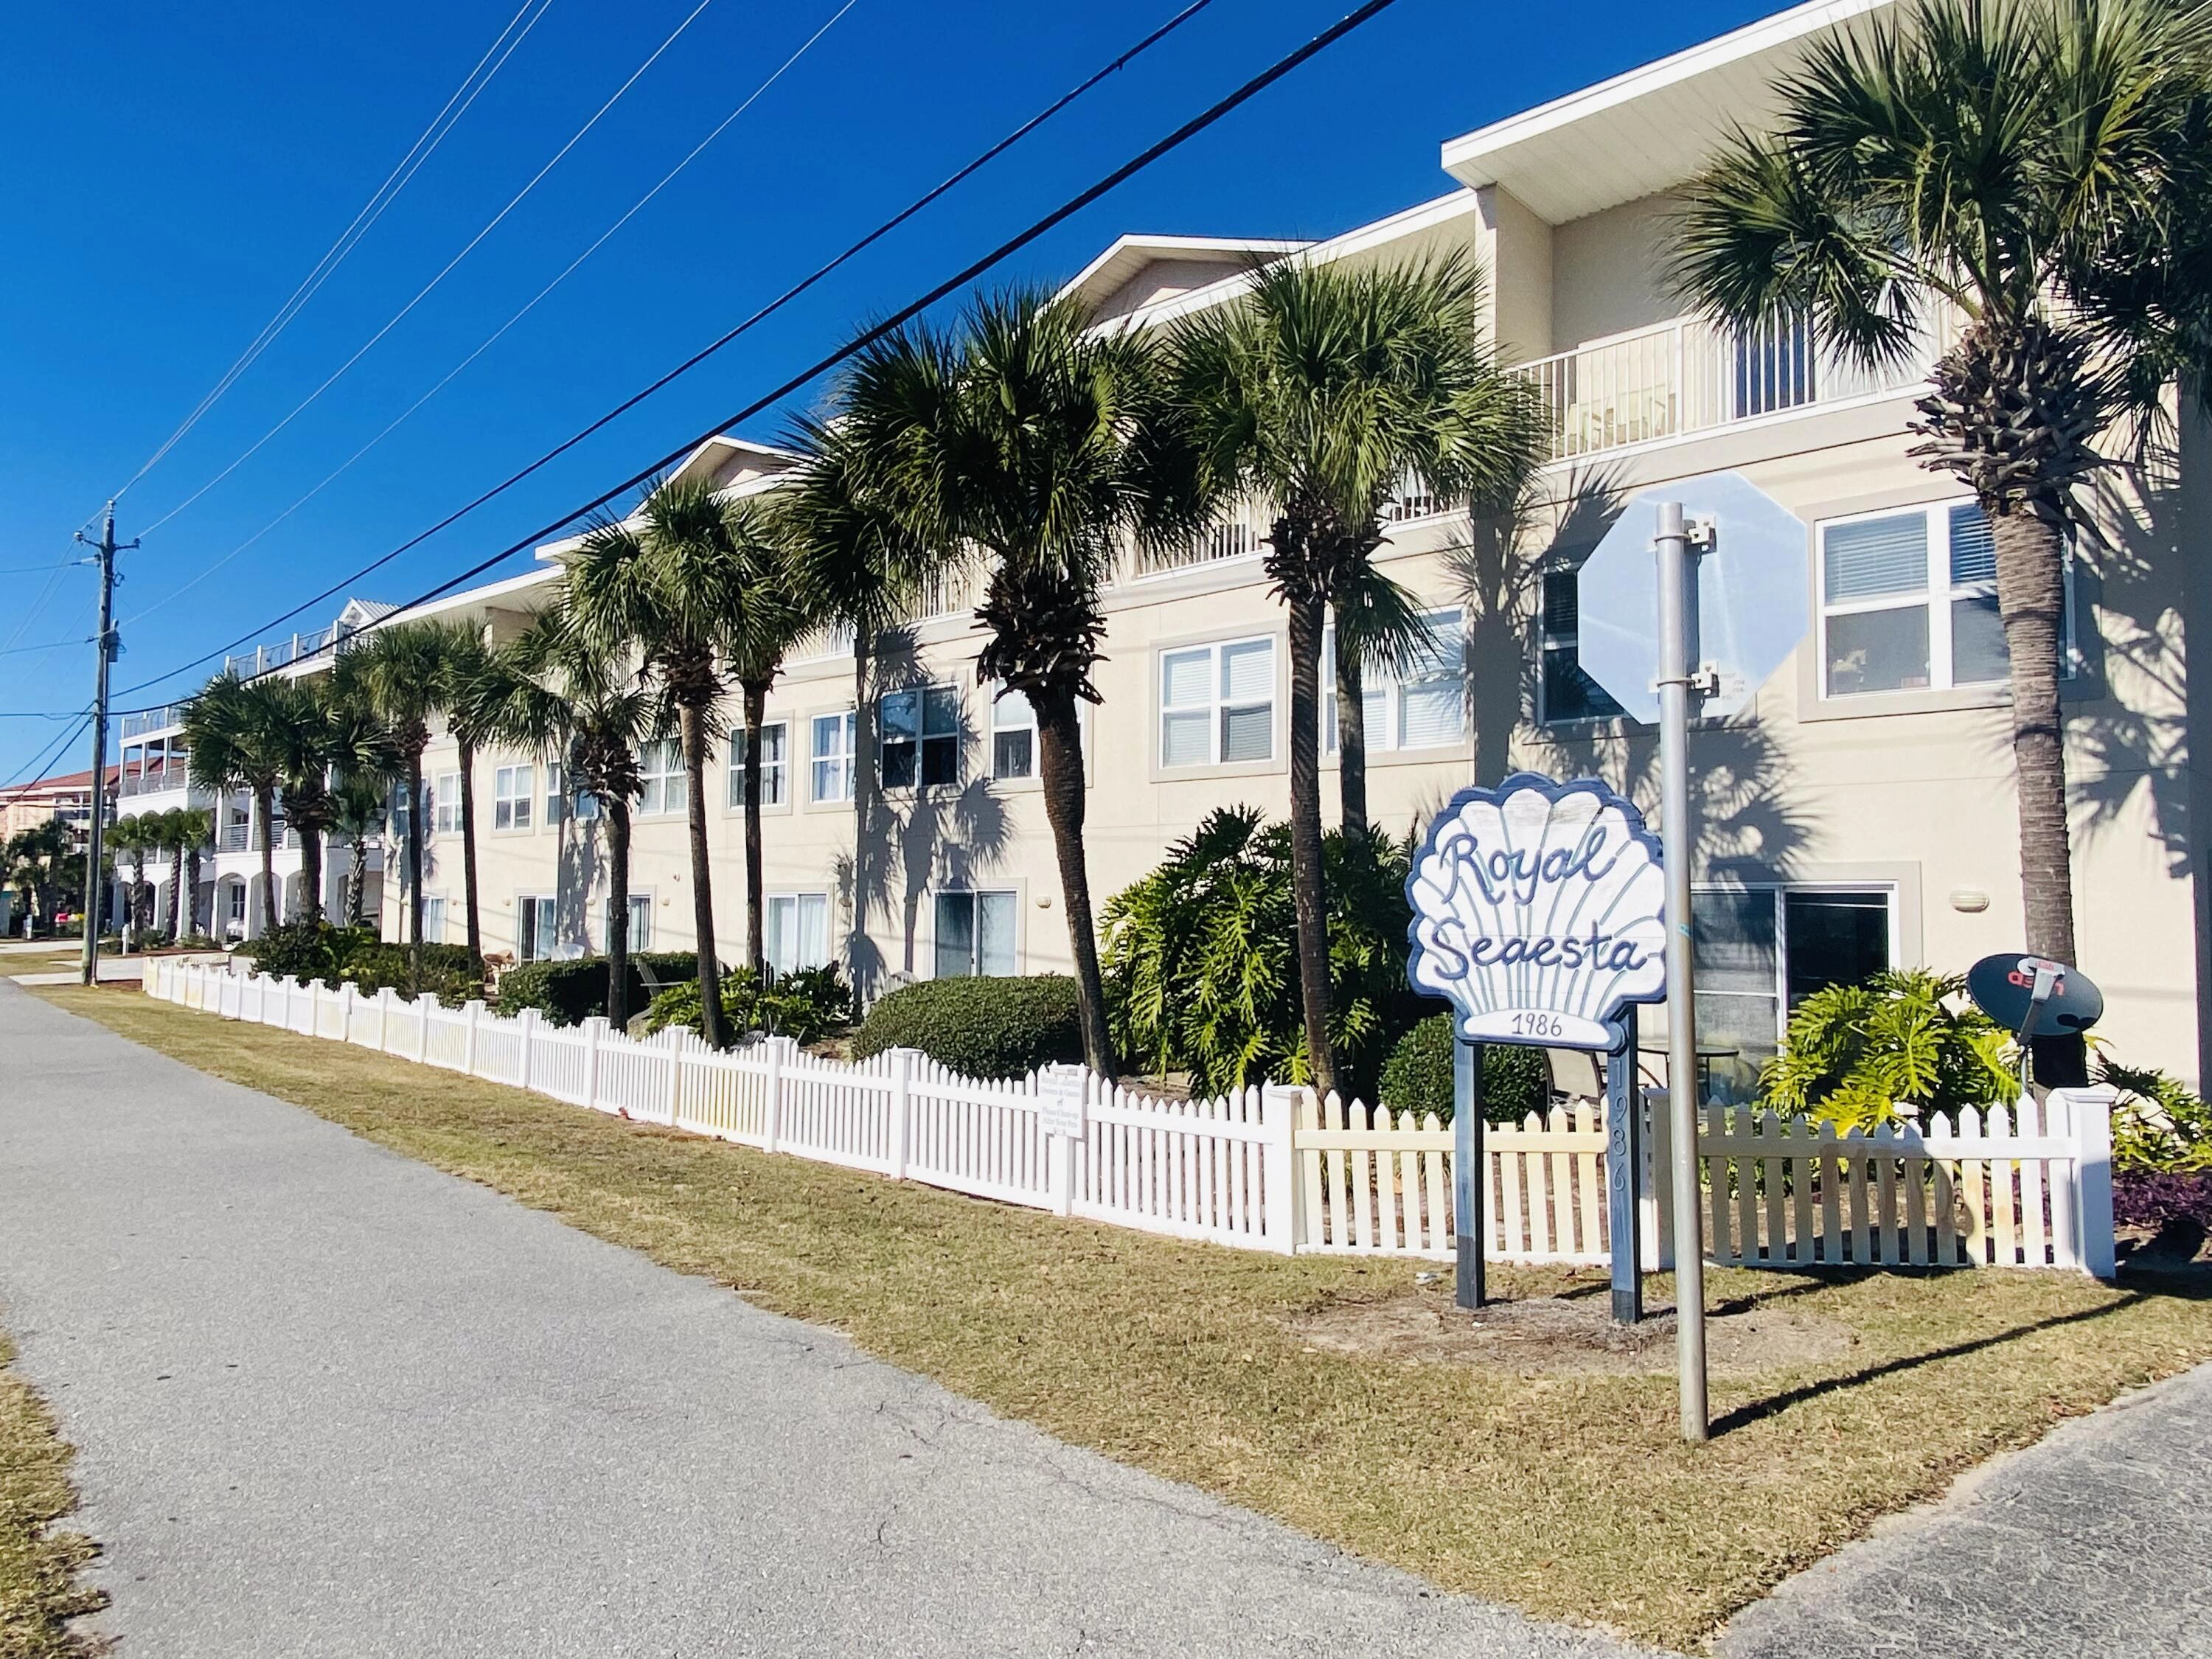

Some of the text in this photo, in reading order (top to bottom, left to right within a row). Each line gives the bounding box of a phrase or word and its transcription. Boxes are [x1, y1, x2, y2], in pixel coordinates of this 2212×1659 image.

[1439, 824, 1617, 906] Royal
[1431, 917, 1649, 981] Seaesta
[1511, 1012, 1562, 1037] 1986
[1613, 1060, 1628, 1192] 1986
